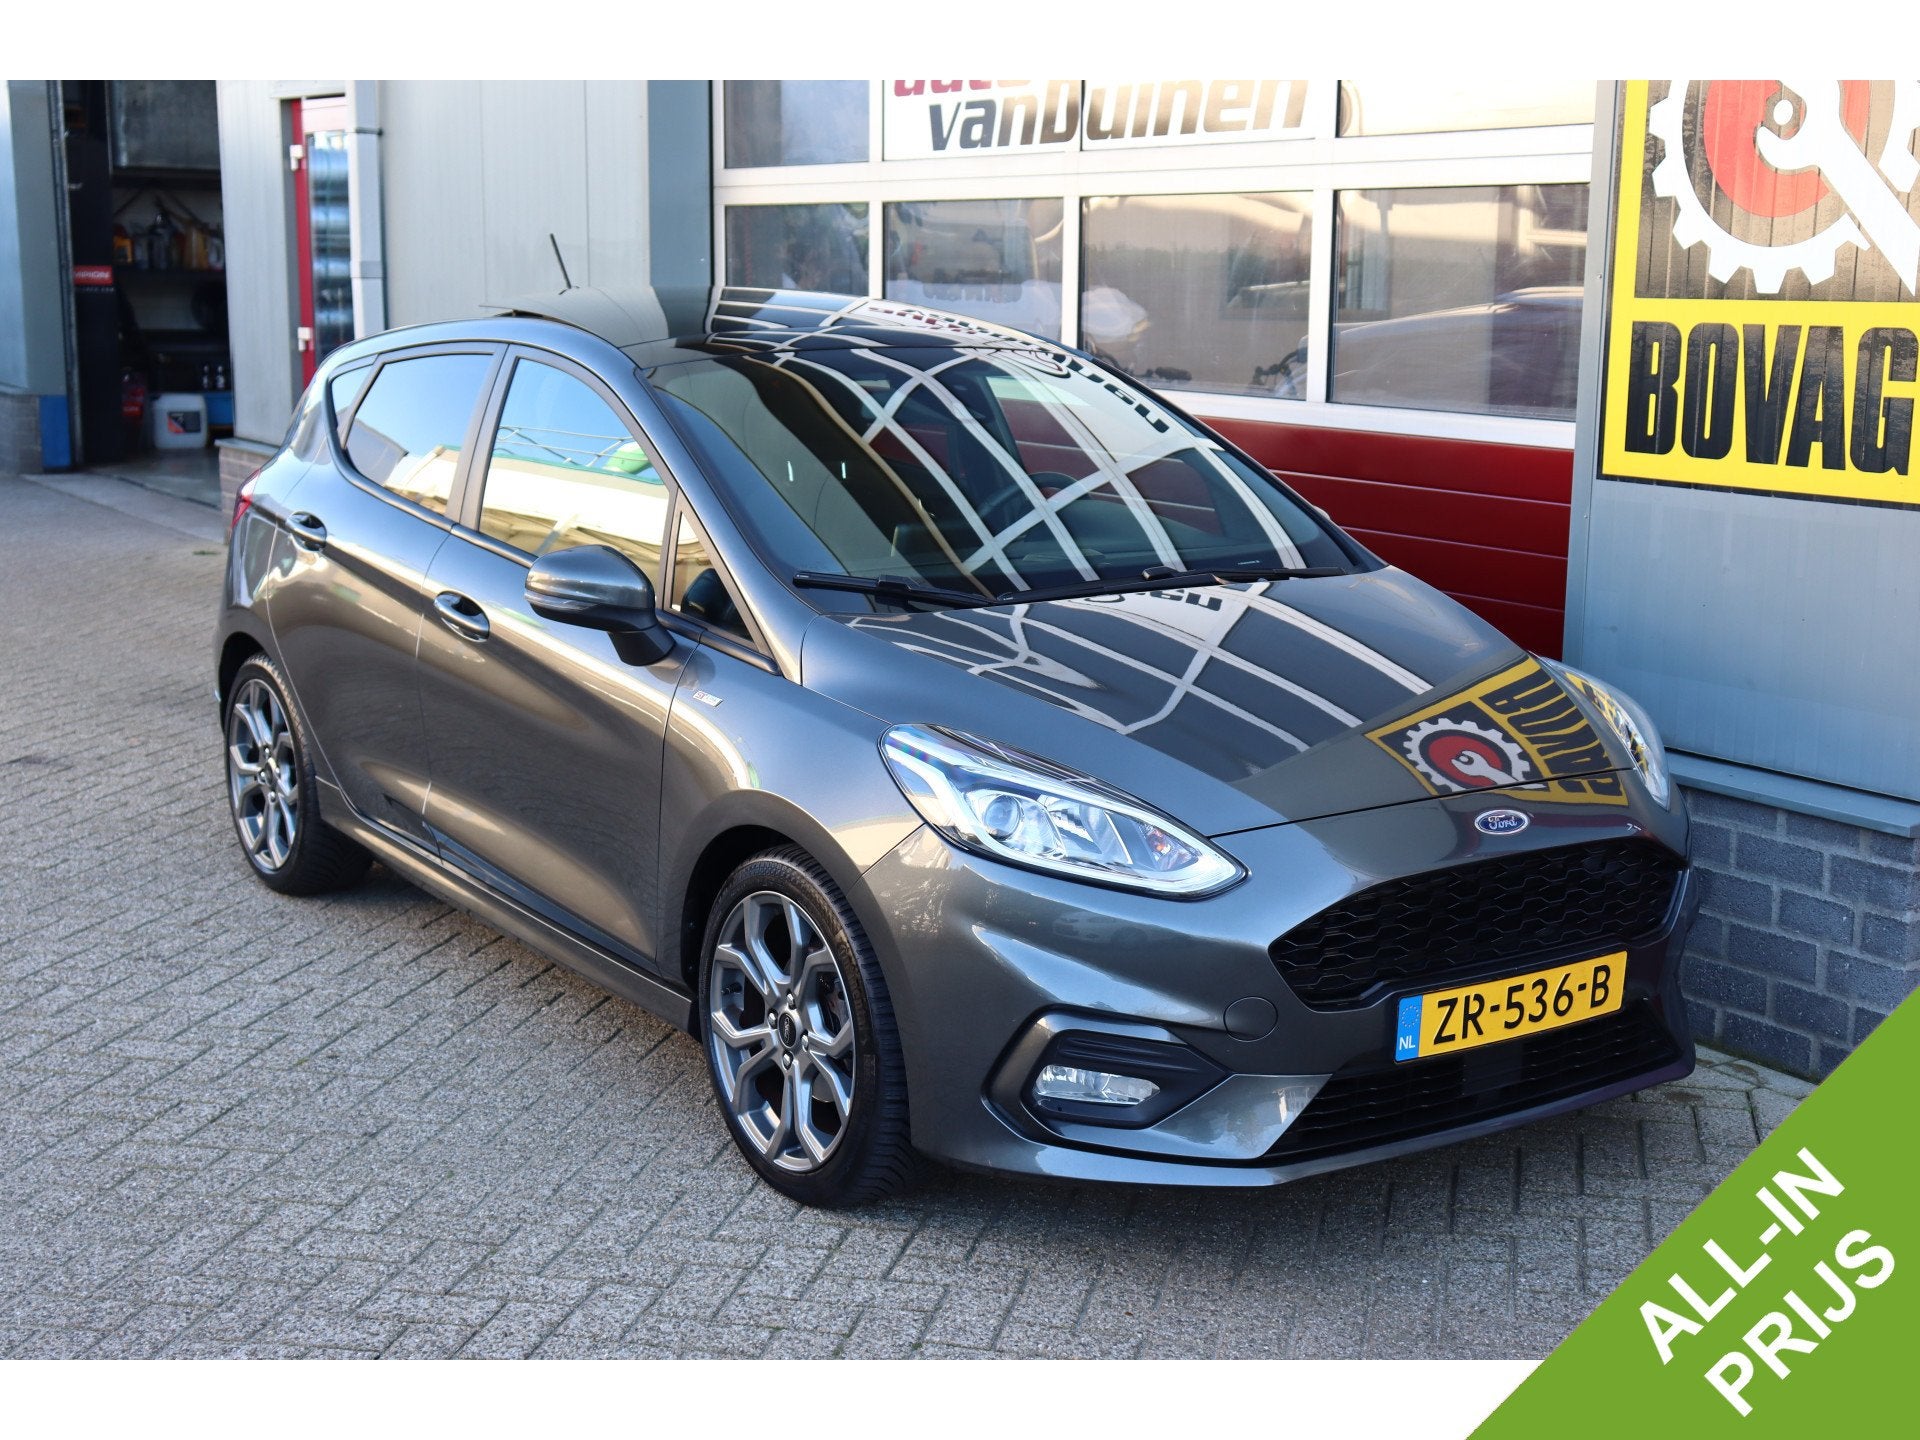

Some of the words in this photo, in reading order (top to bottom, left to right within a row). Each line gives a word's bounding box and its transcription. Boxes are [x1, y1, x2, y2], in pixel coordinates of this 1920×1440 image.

[1624, 320, 1920, 476] BOVAG
[1487, 814, 1518, 830] Ford
[1433, 964, 1611, 1046] ZR-536-B
[1398, 1036, 1416, 1051] NL
